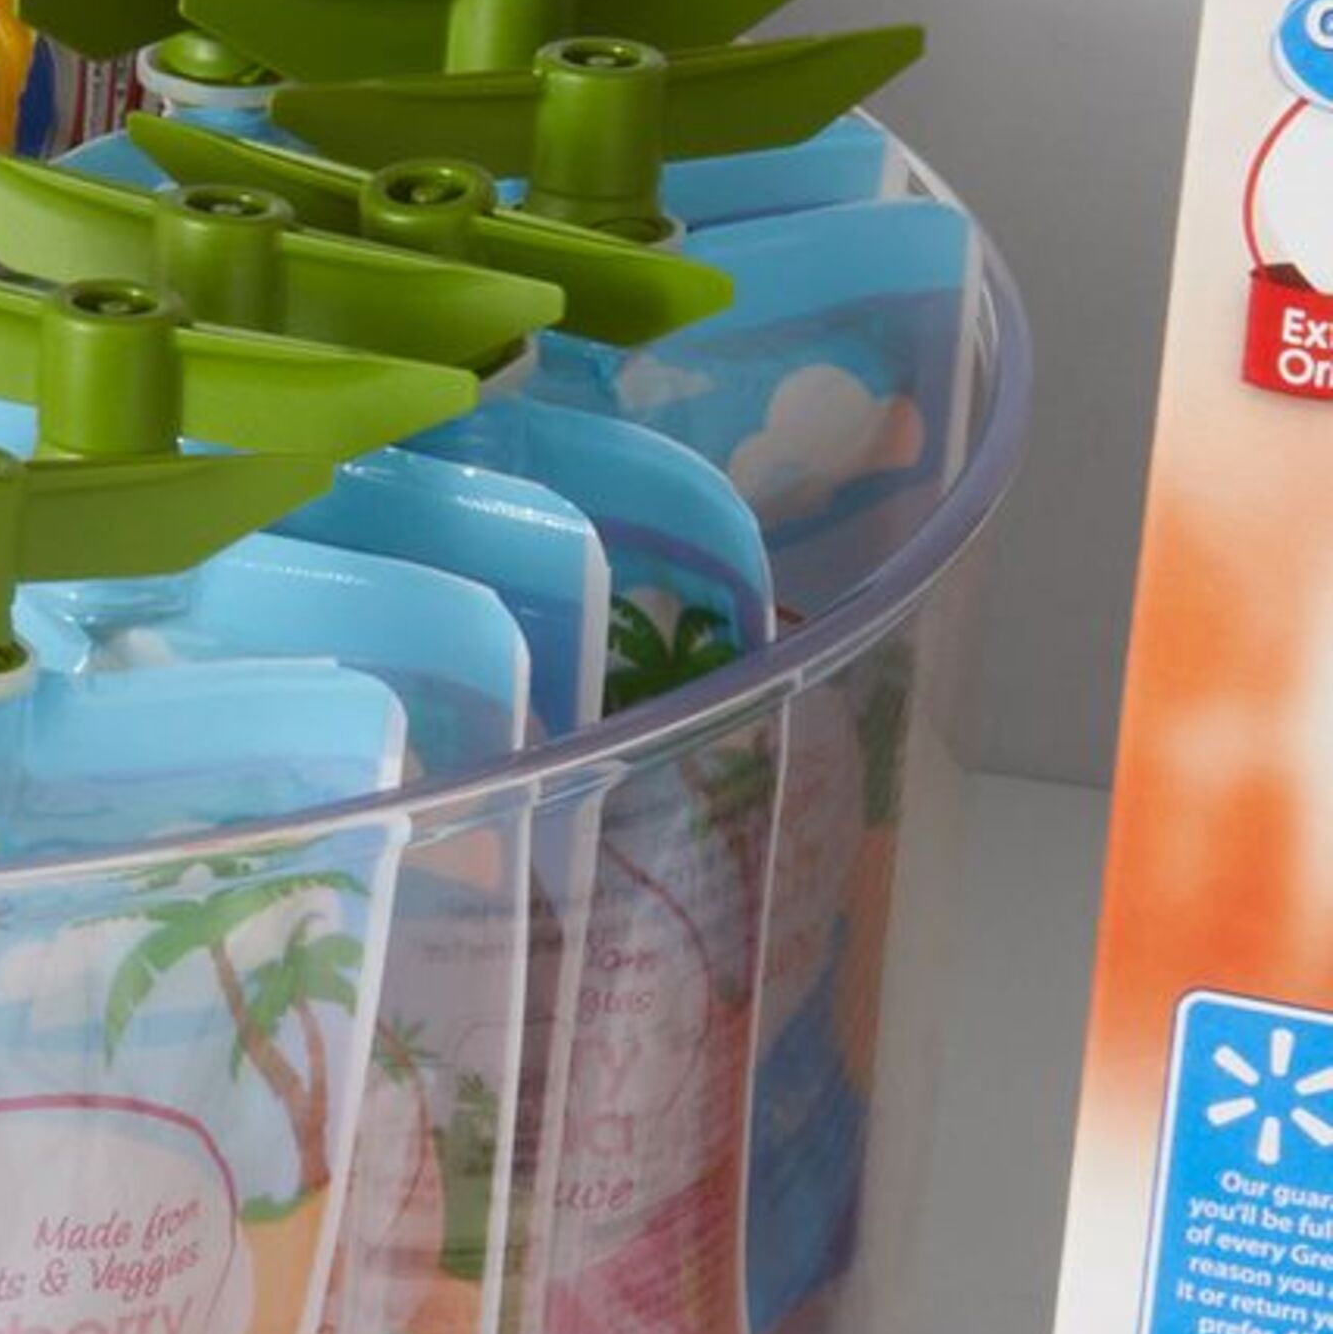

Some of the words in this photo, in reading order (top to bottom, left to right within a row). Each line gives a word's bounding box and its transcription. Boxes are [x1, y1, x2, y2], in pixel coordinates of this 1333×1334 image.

[1282, 306, 1333, 349] Ex
[1220, 1169, 1270, 1198] Our
[34, 1211, 134, 1252] Made
[1189, 1197, 1257, 1226] you'll
[1261, 1206, 1294, 1234] be
[1185, 1223, 1215, 1247] of
[1217, 1232, 1287, 1265] every
[38, 1258, 69, 1297] &
[89, 1240, 201, 1302] Veggies
[1188, 1256, 1273, 1288] reason
[1277, 1274, 1325, 1298] you
[1198, 1287, 1228, 1309] or
[1230, 1294, 1308, 1326] return
